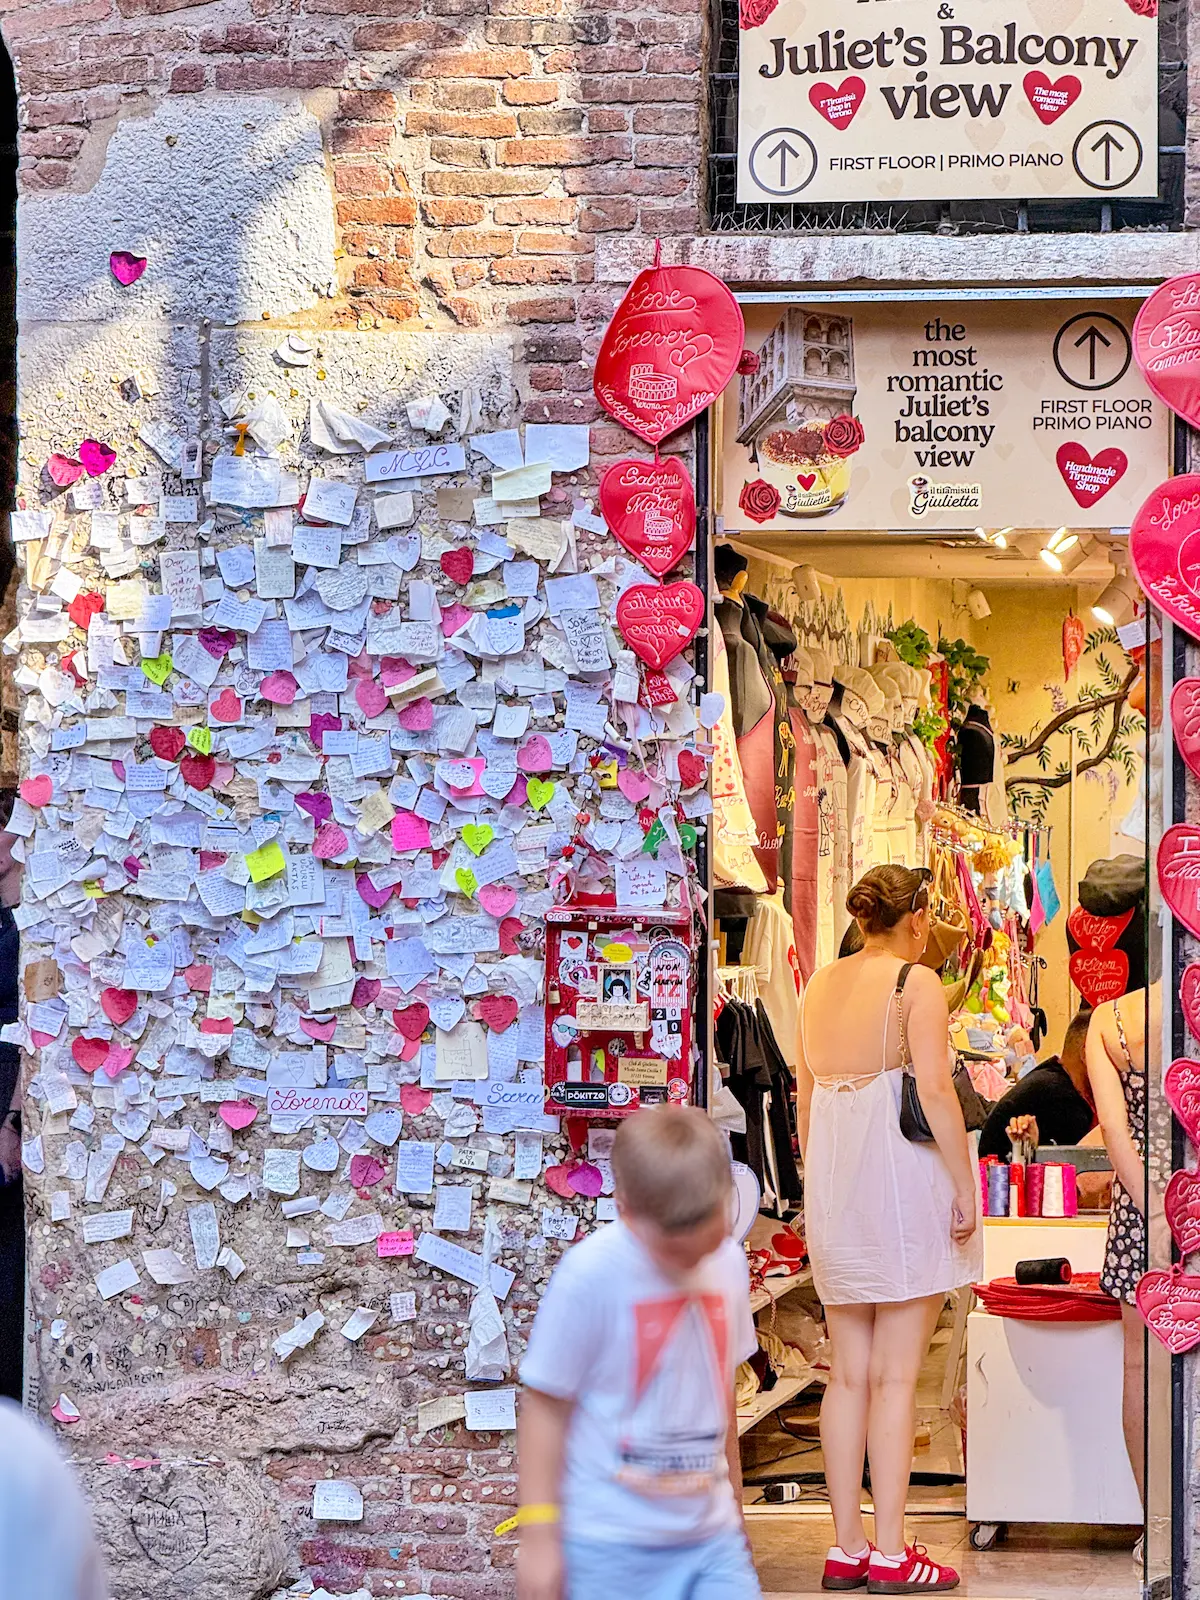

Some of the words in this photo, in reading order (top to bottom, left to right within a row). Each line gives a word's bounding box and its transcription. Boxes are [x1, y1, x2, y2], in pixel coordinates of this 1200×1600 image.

[937, 3, 955, 19] &
[758, 27, 928, 78] Juliet’s
[939, 22, 1139, 79] Balcony
[880, 71, 1013, 120] view
[1032, 95, 1068, 106] romantic
[1034, 86, 1048, 96] The
[1049, 89, 1069, 99] most
[827, 104, 844, 113] shop
[828, 109, 853, 119] Verona
[1040, 102, 1059, 112] view
[829, 156, 874, 171] FIRST
[878, 155, 936, 170] FLOOR
[948, 153, 1005, 169] PRIMO
[1008, 152, 1064, 168] PIANO
[626, 282, 697, 315] Love
[923, 318, 966, 342] the
[610, 324, 695, 357] Forever
[912, 345, 977, 368] most
[886, 370, 1004, 393] romantic
[899, 394, 989, 419] Juliet’s
[1041, 400, 1089, 414] FIRST
[1092, 400, 1152, 414] FLOOR
[1032, 416, 1092, 431] PRIMO
[1095, 415, 1152, 430] PIANO
[894, 419, 995, 448] balcony
[914, 446, 974, 468] view
[620, 467, 682, 486] Sabrina
[1065, 460, 1117, 477] Handmade
[930, 486, 936, 494] il
[970, 486, 979, 494] di
[1075, 480, 1100, 494] Shop
[786, 495, 830, 511] Giulietta
[911, 490, 979, 515] Giulietta
[640, 545, 673, 559] 2025
[271, 1090, 350, 1111] Lorena
[1148, 1278, 1200, 1299] Mumm
